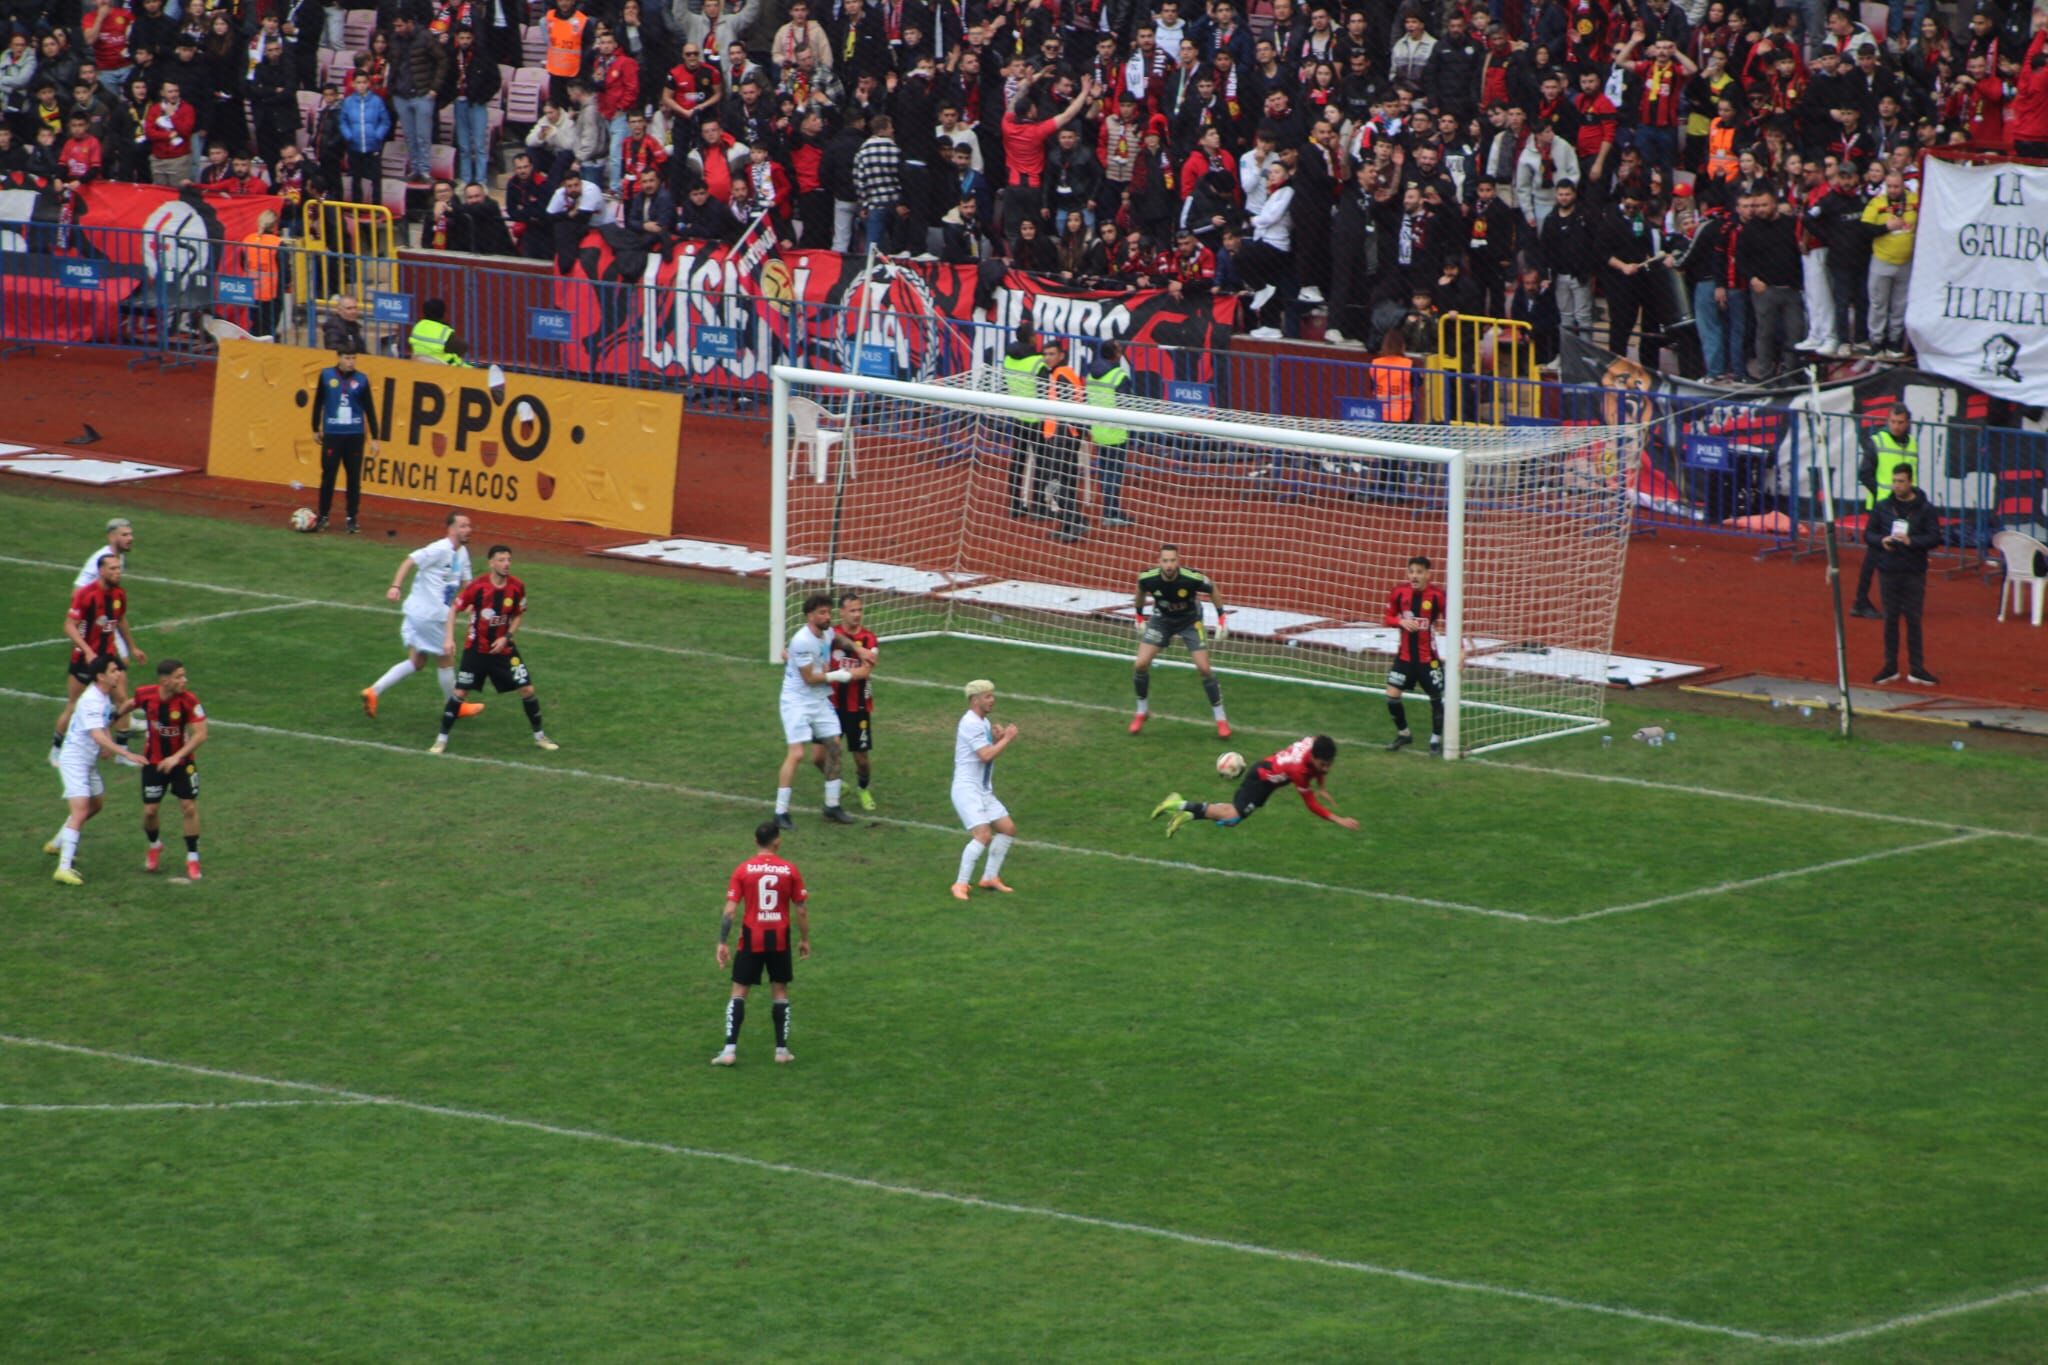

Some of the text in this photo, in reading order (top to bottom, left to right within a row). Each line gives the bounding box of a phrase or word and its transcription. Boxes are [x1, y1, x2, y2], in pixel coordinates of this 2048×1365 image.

[1993, 171, 2024, 207] LA
[66, 263, 93, 277] POLİS
[220, 280, 247, 293] POLİS
[377, 297, 403, 311] POLİS
[538, 314, 565, 327] POLİS
[701, 330, 729, 345] POLİS
[340, 393, 350, 406] 5
[379, 376, 551, 462] IPPO
[362, 456, 519, 501] RENCH TACOS
[510, 663, 529, 680] 26
[746, 863, 791, 875] turknet
[758, 874, 779, 911] 6
